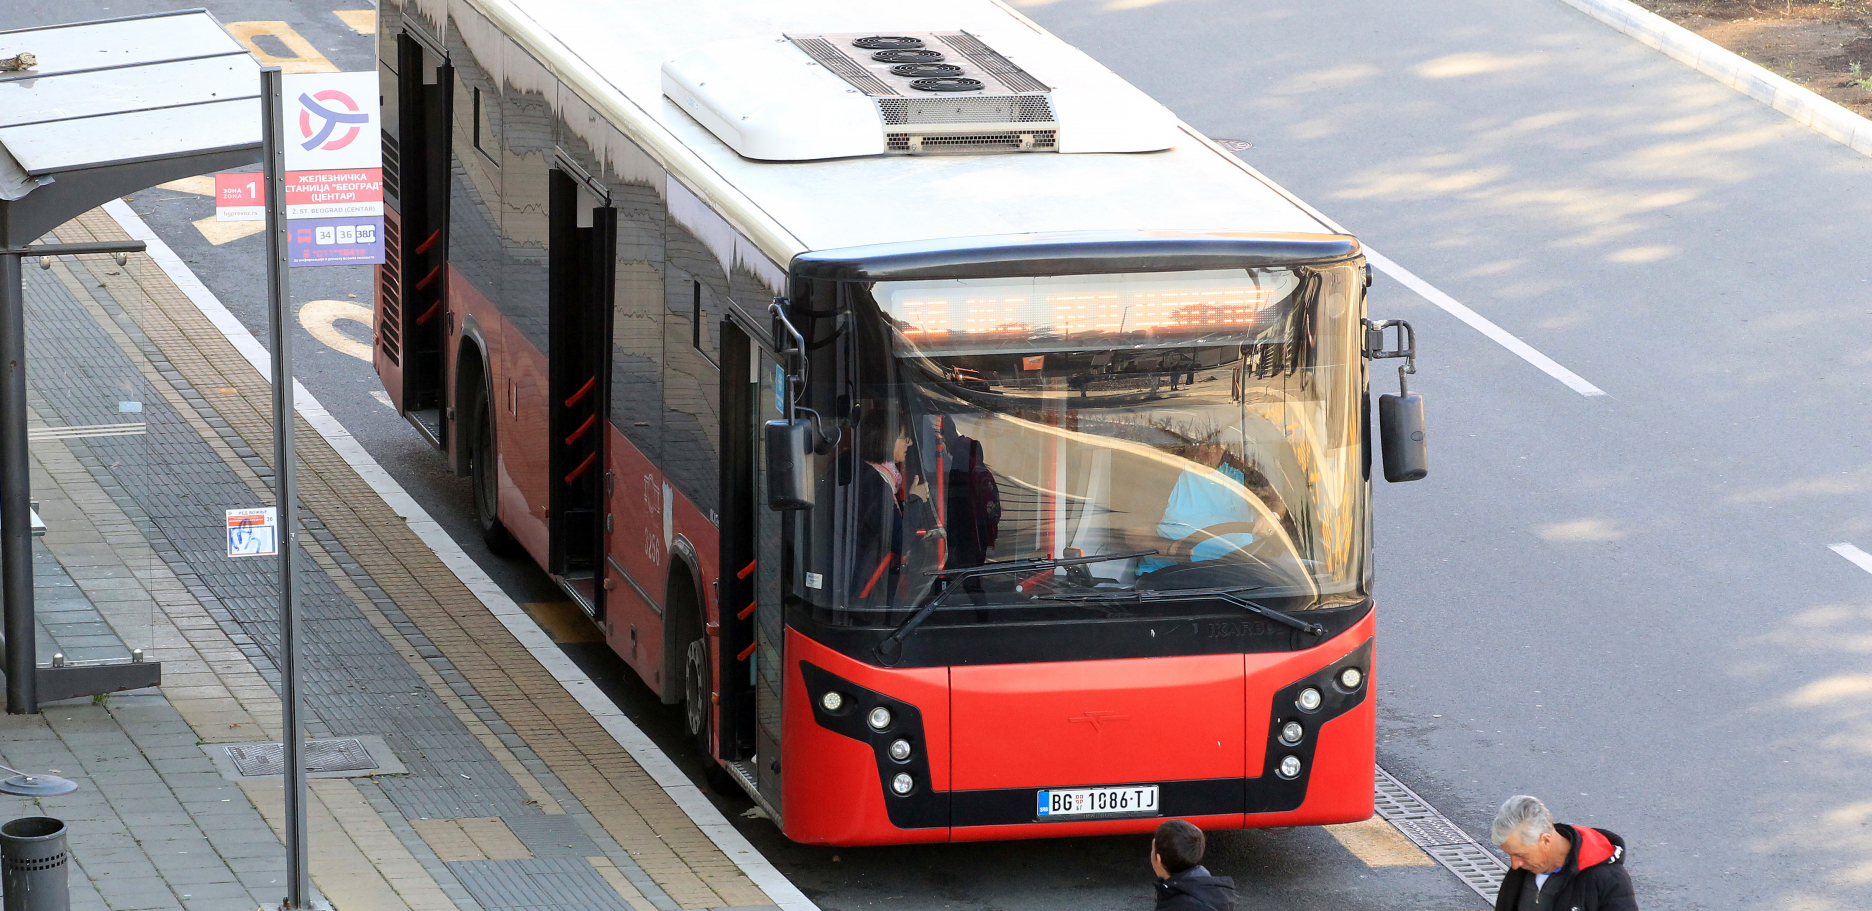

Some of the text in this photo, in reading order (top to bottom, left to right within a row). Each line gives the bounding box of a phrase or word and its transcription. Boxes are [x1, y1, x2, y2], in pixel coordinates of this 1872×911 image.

[299, 173, 367, 183] ЖЕЛЕЗНИЧКА
[246, 181, 256, 199] 1
[285, 182, 383, 193] СТАНИЦА "БЕОГРАД"
[311, 192, 356, 202] (ЦЕНТАР)
[319, 231, 332, 240] 34
[339, 230, 353, 239] 36
[1052, 793, 1072, 812] BG
